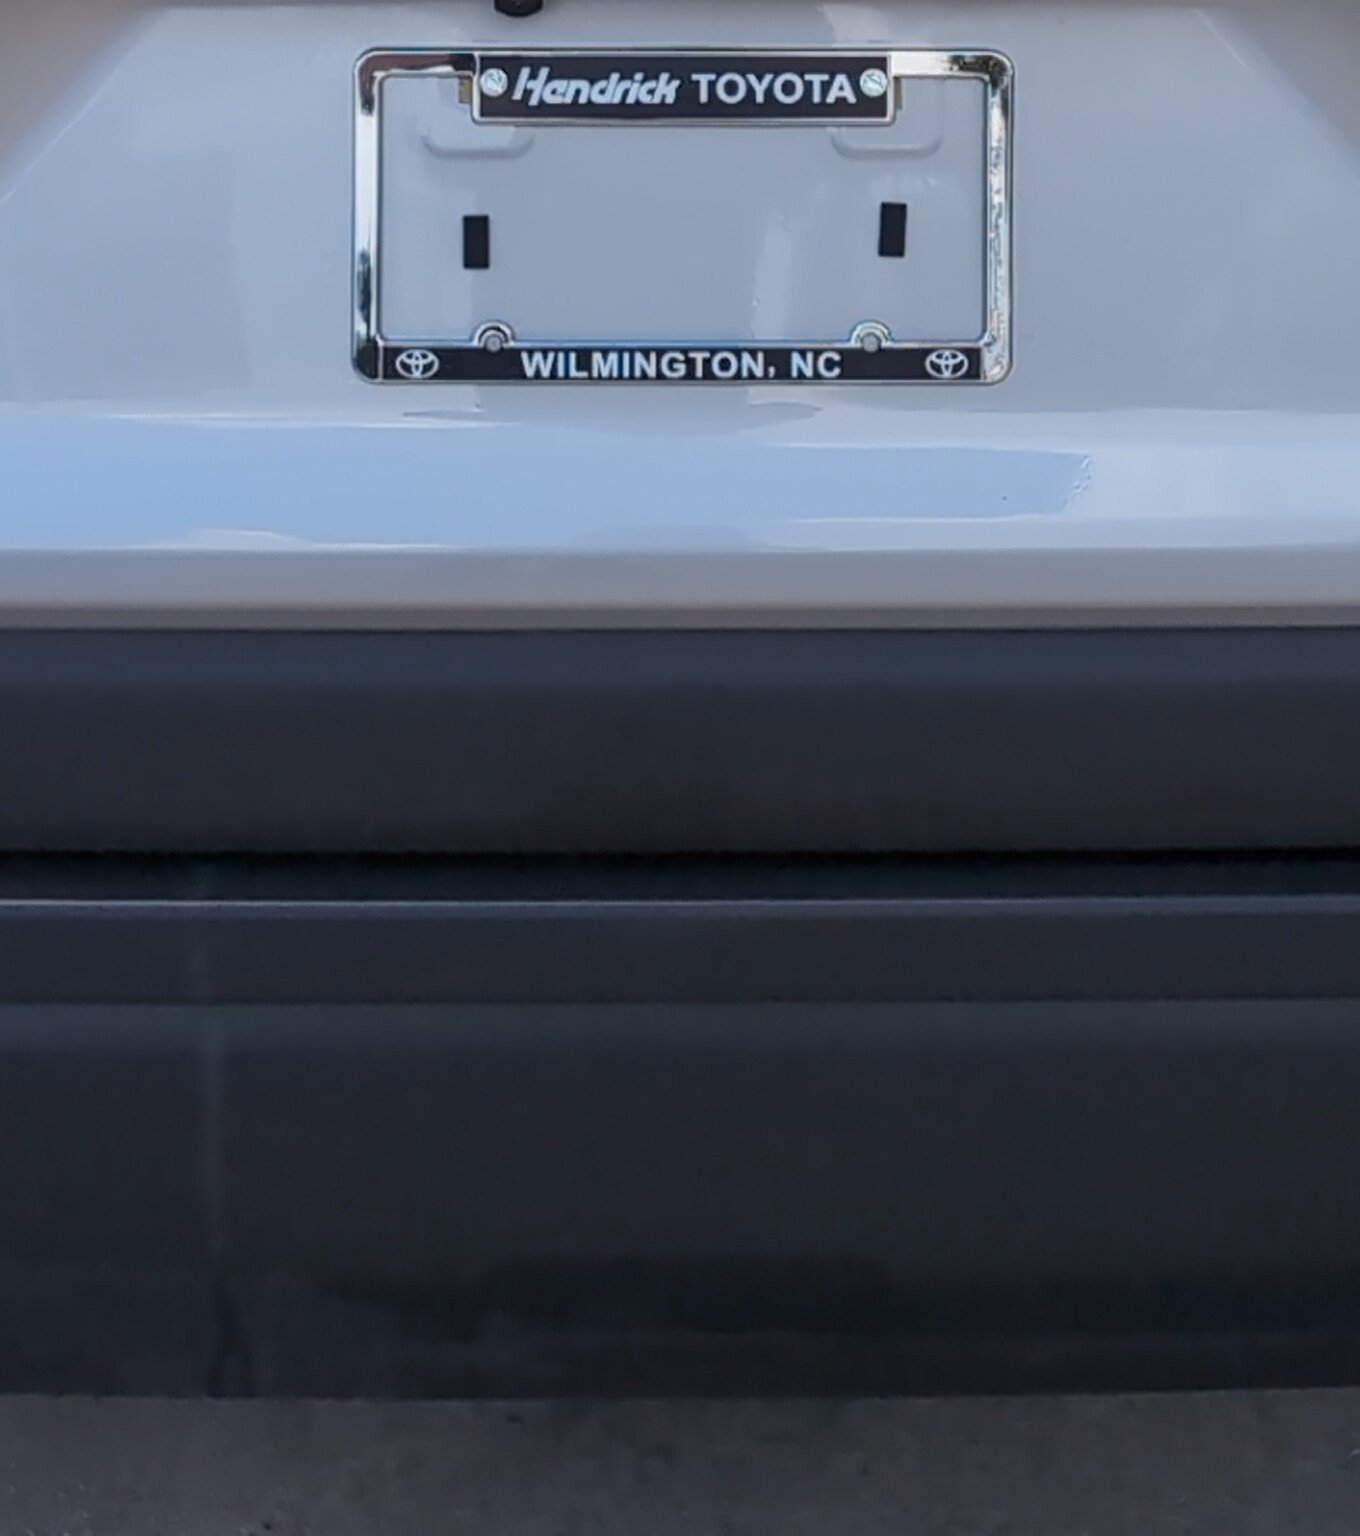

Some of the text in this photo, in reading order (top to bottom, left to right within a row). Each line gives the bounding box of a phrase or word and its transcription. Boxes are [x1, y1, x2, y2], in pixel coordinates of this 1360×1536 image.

[512, 67, 857, 106] Hendrick TOYOTA
[520, 351, 842, 380] WILMINGTON, NC
